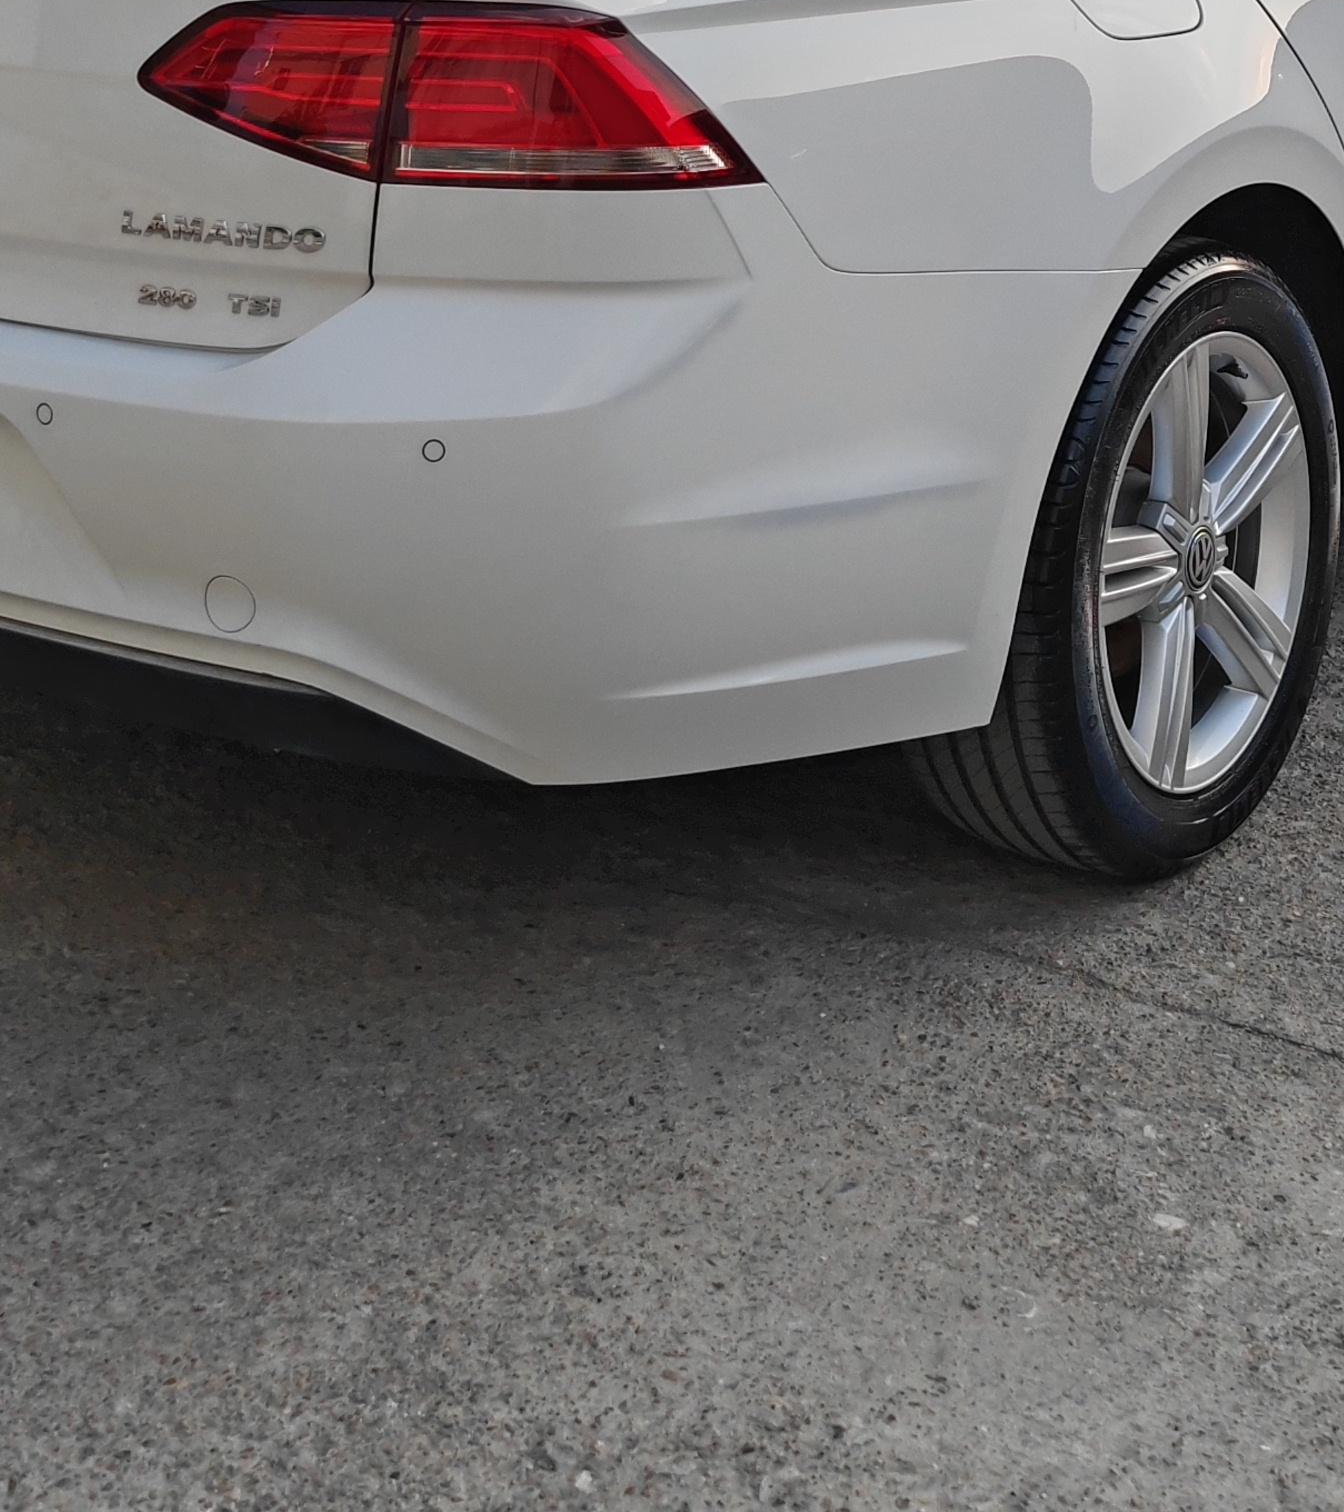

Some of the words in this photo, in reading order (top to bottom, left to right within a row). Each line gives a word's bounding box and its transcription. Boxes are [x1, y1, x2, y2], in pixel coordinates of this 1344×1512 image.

[121, 209, 327, 253] LAMANDO
[138, 284, 197, 309] 280
[228, 292, 282, 318] TSI
